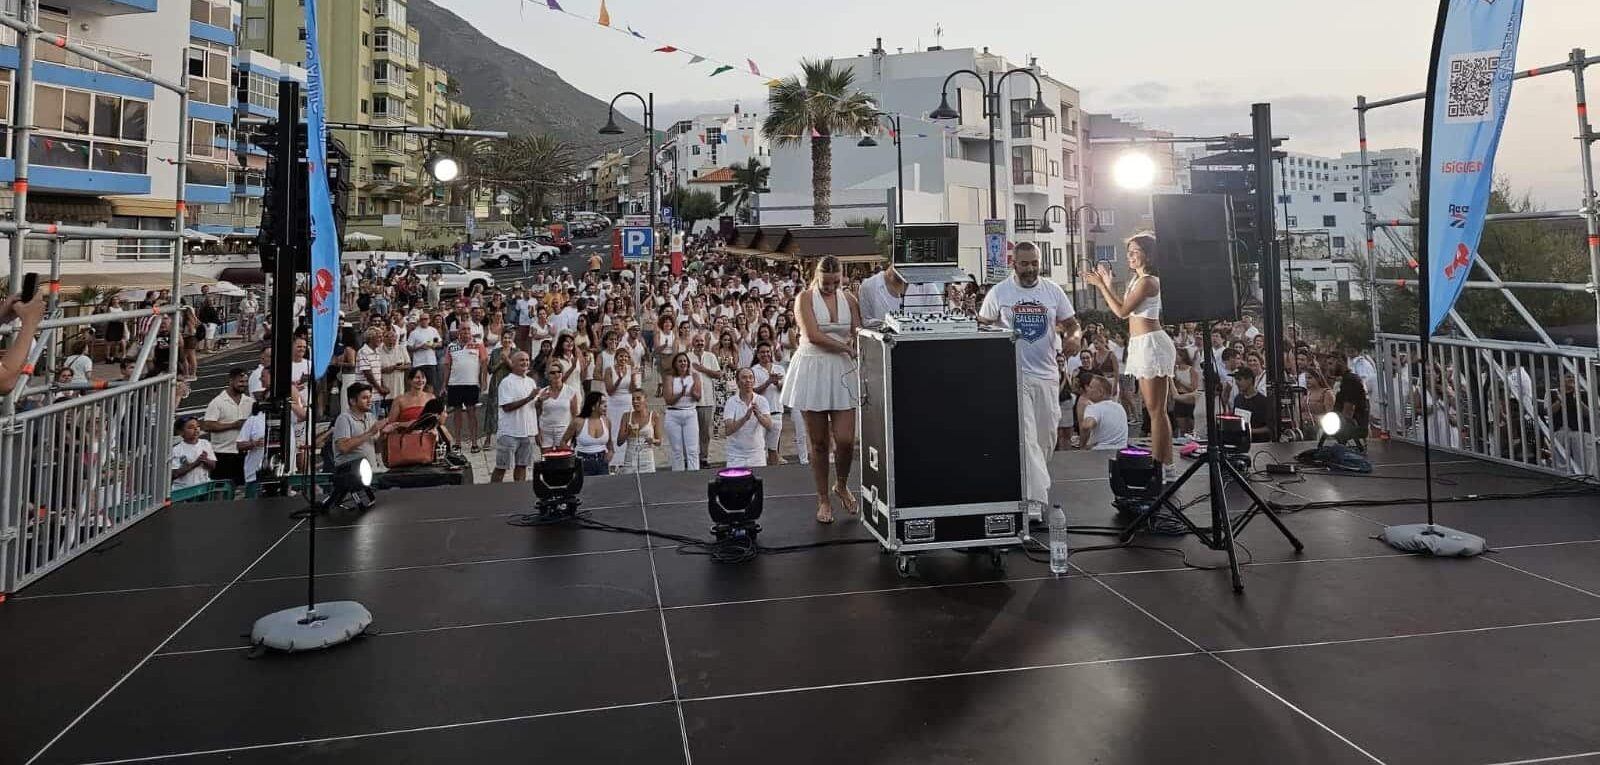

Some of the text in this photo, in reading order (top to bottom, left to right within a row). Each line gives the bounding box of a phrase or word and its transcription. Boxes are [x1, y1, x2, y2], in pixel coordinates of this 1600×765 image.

[663, 208, 671, 216] P
[627, 230, 646, 254] P
[1015, 314, 1045, 323] SALSERA
